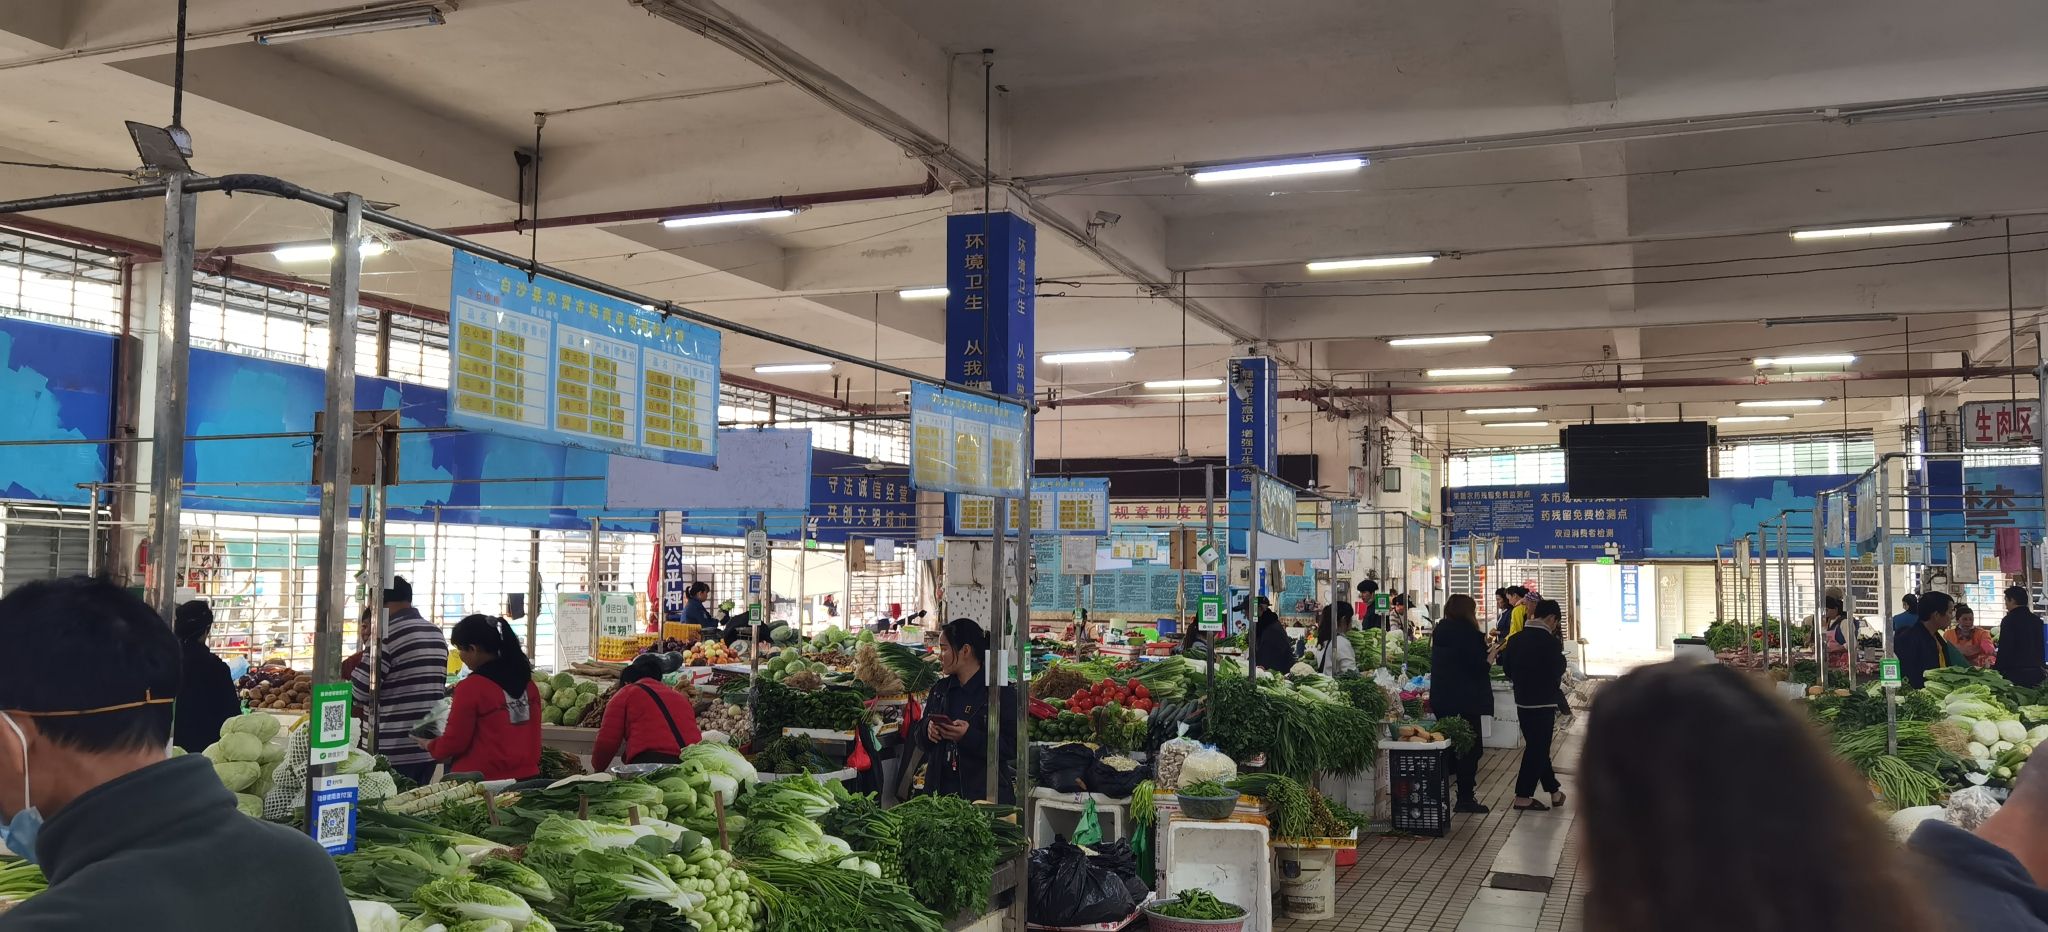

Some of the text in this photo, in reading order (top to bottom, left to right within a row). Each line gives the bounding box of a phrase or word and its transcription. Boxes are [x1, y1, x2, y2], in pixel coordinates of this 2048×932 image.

[964, 233, 985, 310] 环境卫生
[1016, 237, 1026, 315] 环境卫生
[1975, 404, 2034, 441] 生肉区
[828, 475, 908, 504] 守法诚信经营
[827, 504, 907, 528] 共创文明城市
[1541, 509, 1628, 522] 药残留免费检测点
[1554, 528, 1614, 538] 欢迎消费者检测
[664, 547, 683, 611] 公平秤
